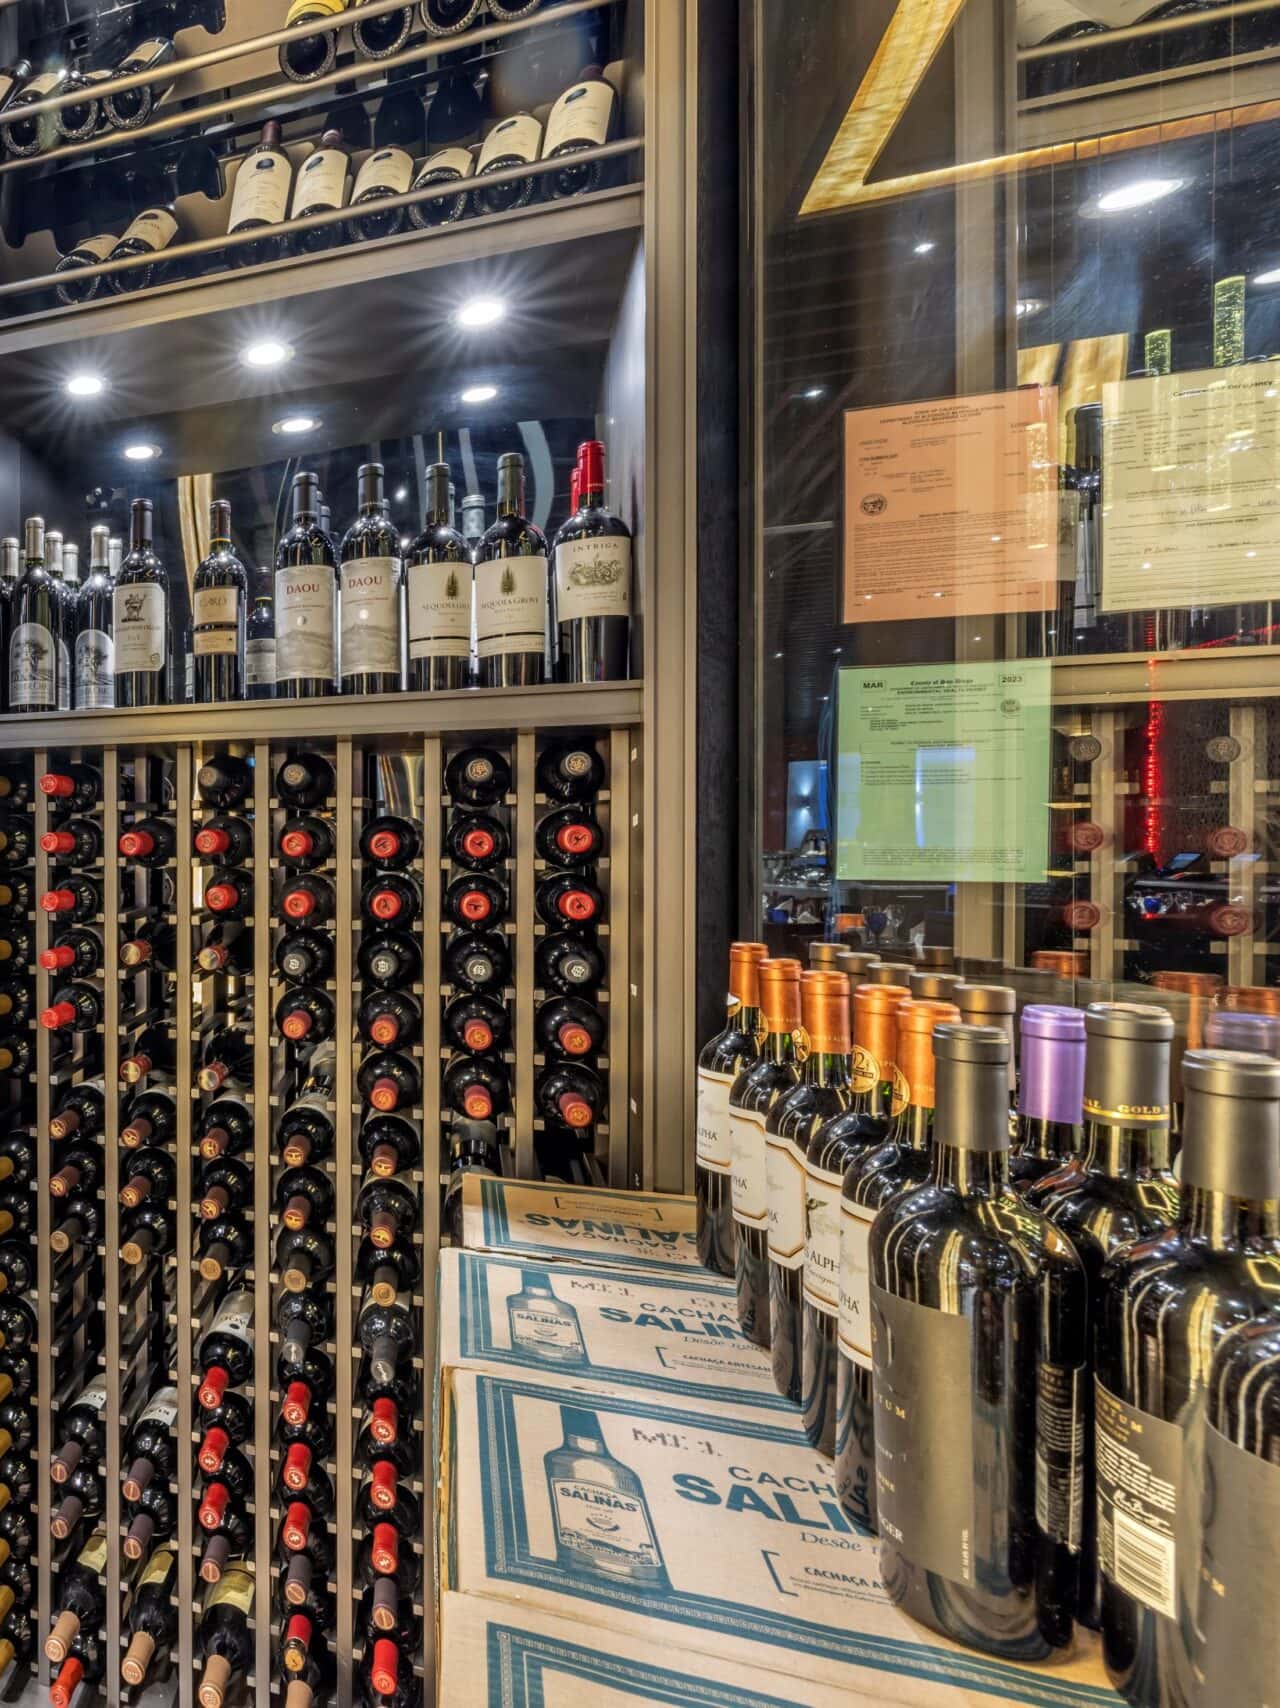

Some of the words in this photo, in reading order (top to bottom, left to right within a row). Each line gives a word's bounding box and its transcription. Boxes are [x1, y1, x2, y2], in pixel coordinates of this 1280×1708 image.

[573, 542, 619, 553] INTRIGA
[348, 575, 383, 588] DAOU
[286, 584, 320, 595] DAOU
[1117, 1104, 1161, 1114] GOLD
[517, 1313, 572, 1327] SALINAS
[560, 1487, 638, 1512] SALINAS
[800, 1531, 861, 1551] Desde
[804, 1567, 869, 1586] CACHAÇA
